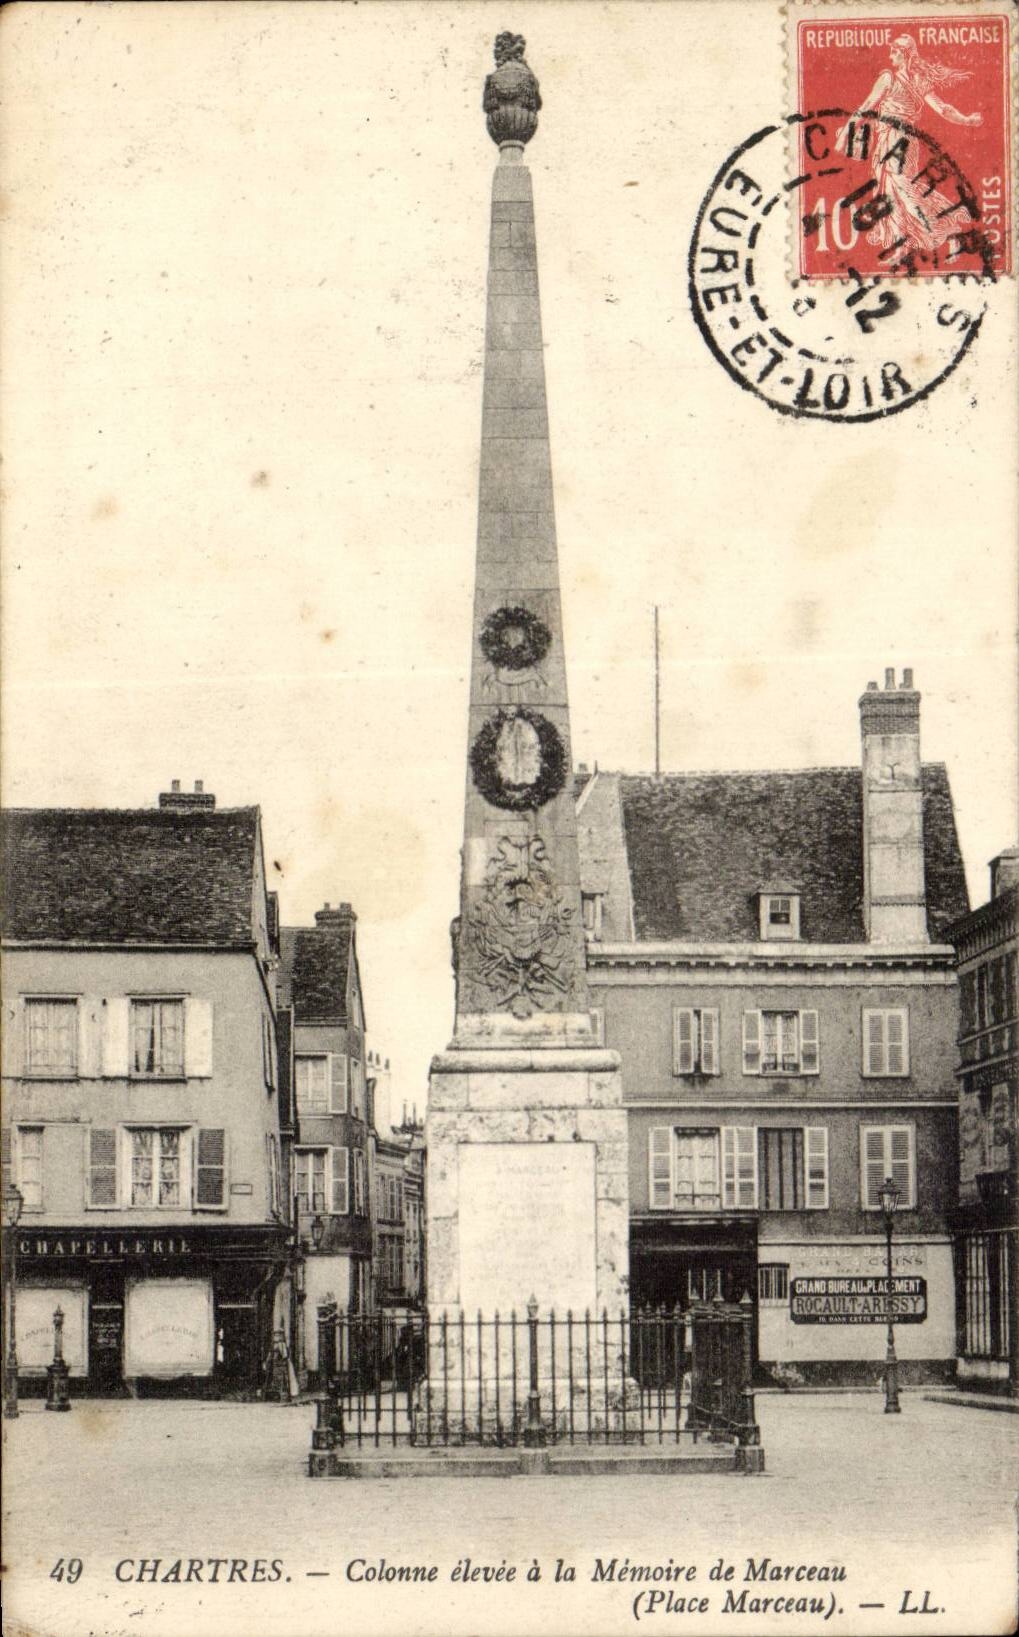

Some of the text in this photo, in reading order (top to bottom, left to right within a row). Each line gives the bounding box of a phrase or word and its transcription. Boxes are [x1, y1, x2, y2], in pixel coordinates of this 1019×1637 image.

[918, 25, 1000, 45] FRANÇAISE
[812, 197, 859, 251] 10
[983, 175, 1002, 260] OSTES
[19, 1239, 191, 1254] CHAPELLERIE
[795, 1280, 827, 1294] GRAND
[828, 1280, 863, 1294] BUREAU
